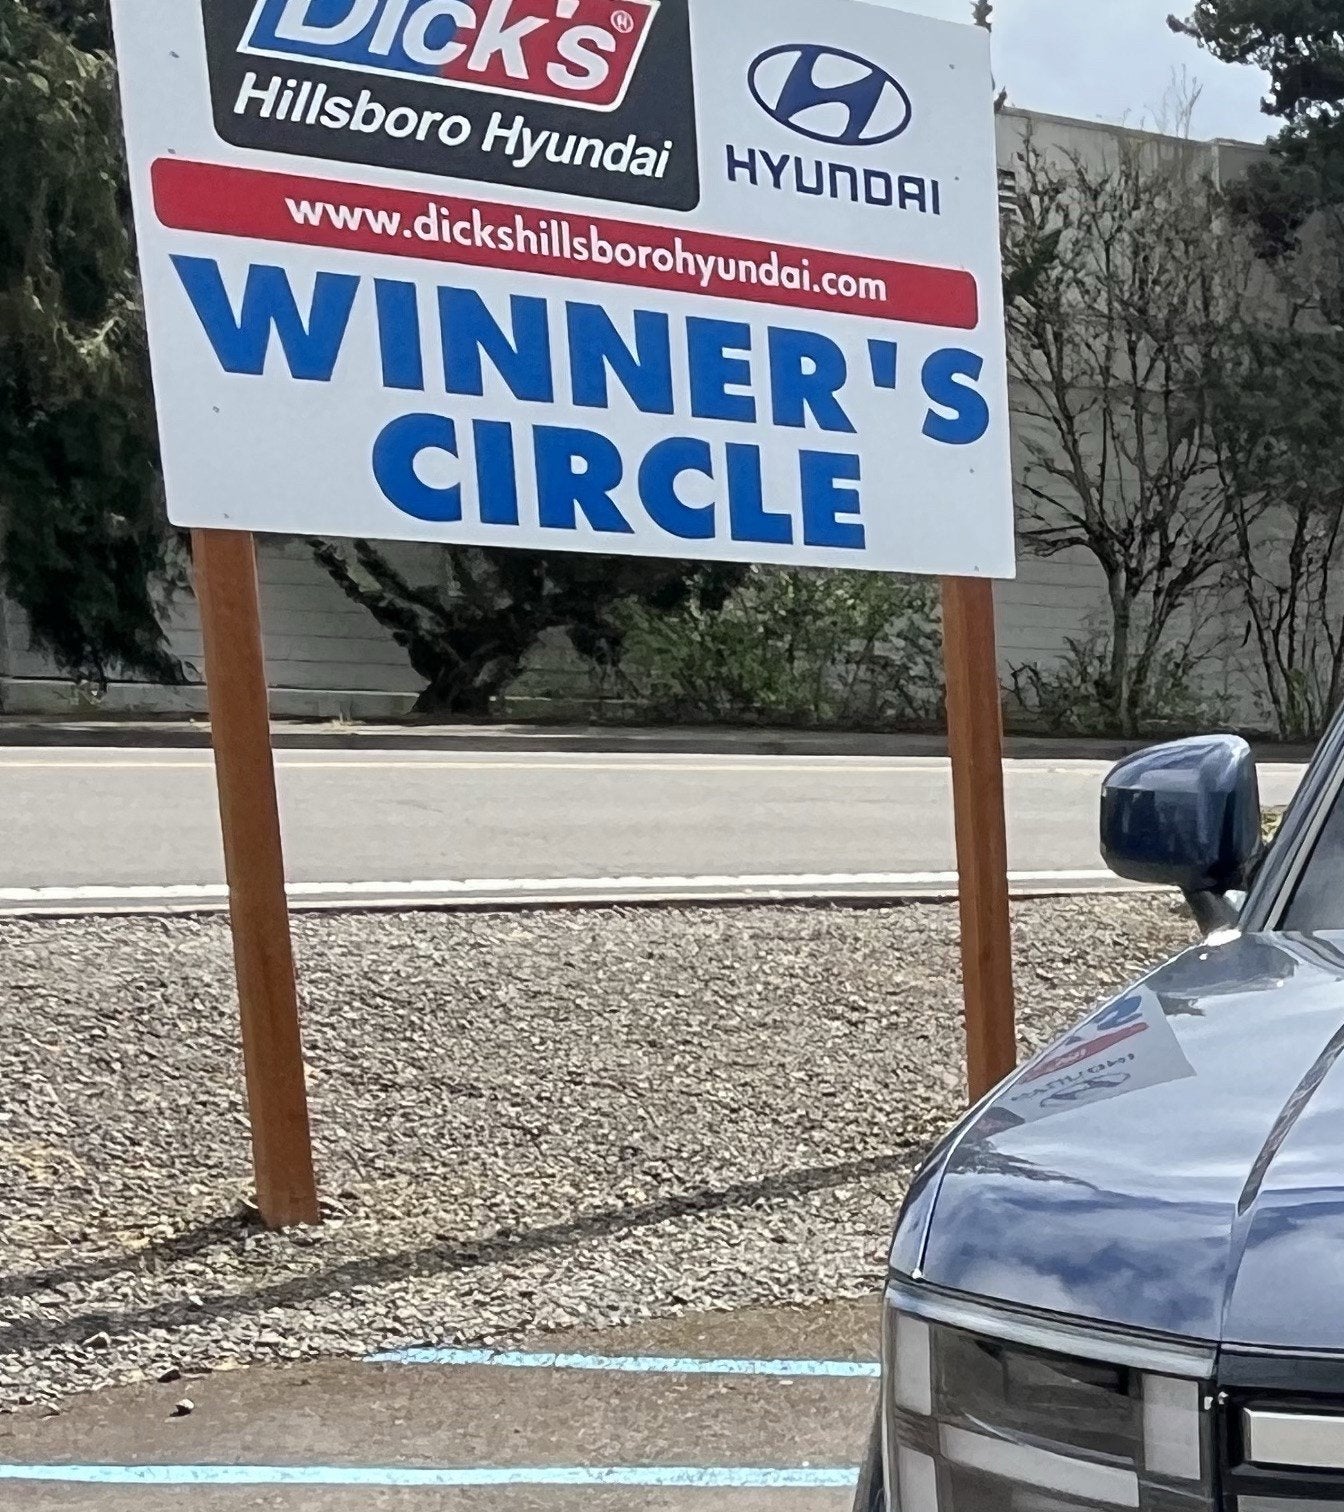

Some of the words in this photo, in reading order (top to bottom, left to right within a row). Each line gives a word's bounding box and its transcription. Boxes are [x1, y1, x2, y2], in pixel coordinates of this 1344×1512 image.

[233, 71, 471, 147] Hillsboro
[481, 111, 673, 178] Hyundai
[725, 144, 941, 216] HYUNDAI
[284, 193, 888, 303] www.dickshillsborohyundai.com
[168, 253, 990, 446] WINNER'S
[371, 412, 867, 551] CIRCLE
